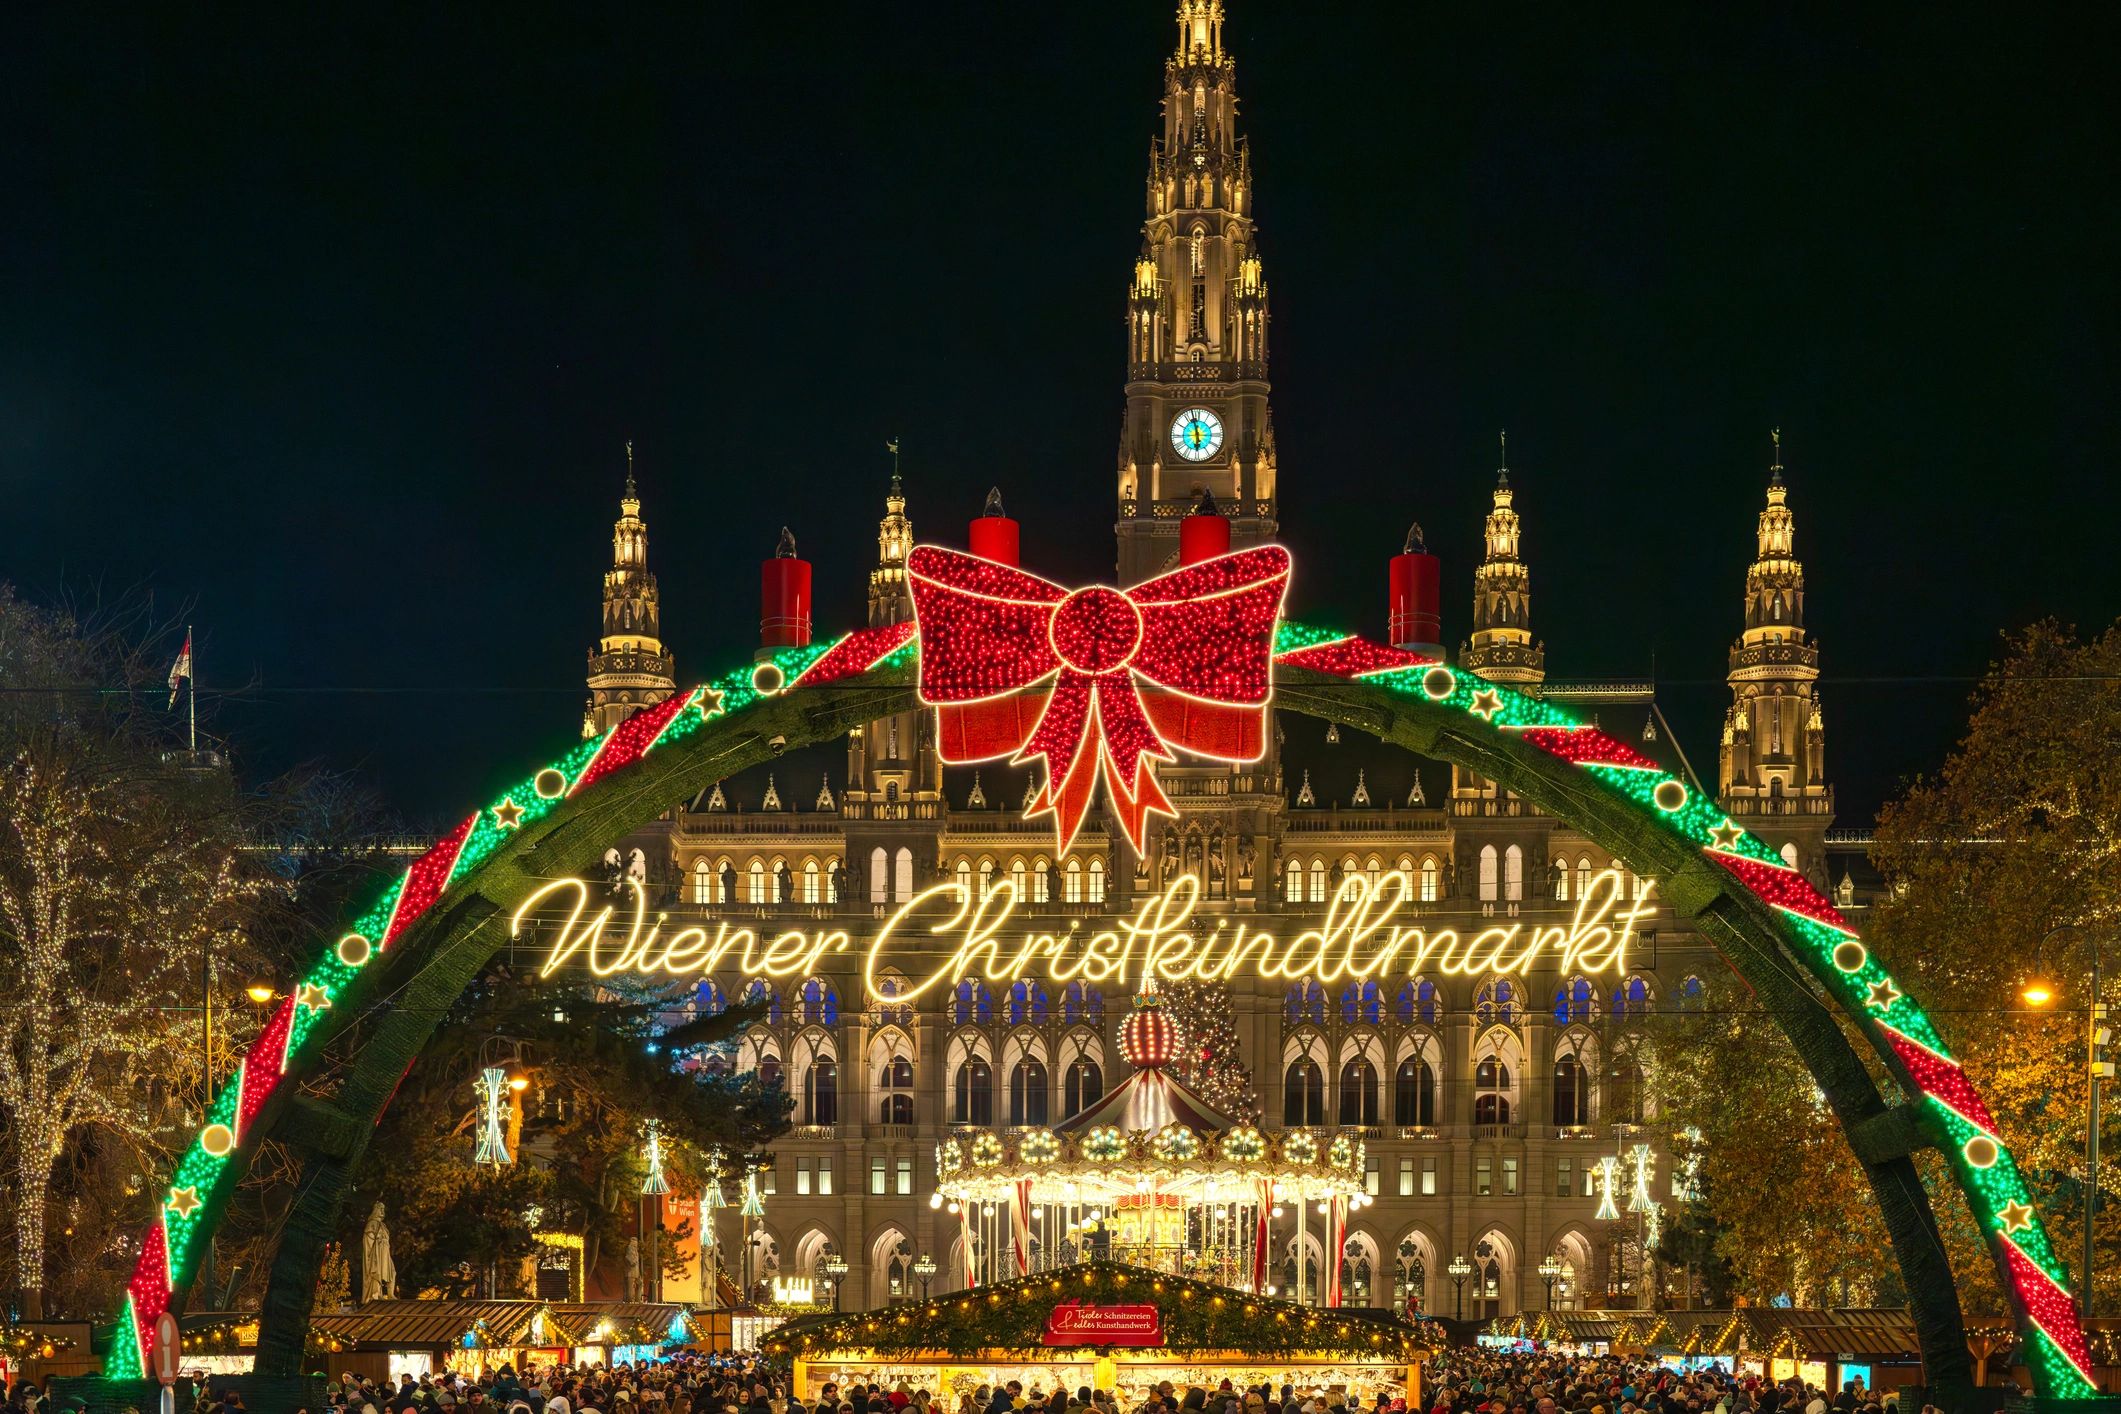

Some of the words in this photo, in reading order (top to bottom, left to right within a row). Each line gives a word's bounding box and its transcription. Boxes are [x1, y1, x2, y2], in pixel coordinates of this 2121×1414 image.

[511, 875, 849, 978] Wiener
[866, 869, 1657, 1003] Christkindlmarkt
[679, 1206, 694, 1217] Wien
[1075, 1309, 1102, 1319] Tiroler
[1104, 1312, 1151, 1320] Schnitzereien
[1073, 1319, 1095, 1329] edles
[1096, 1321, 1151, 1329] Kunsthandwerk
